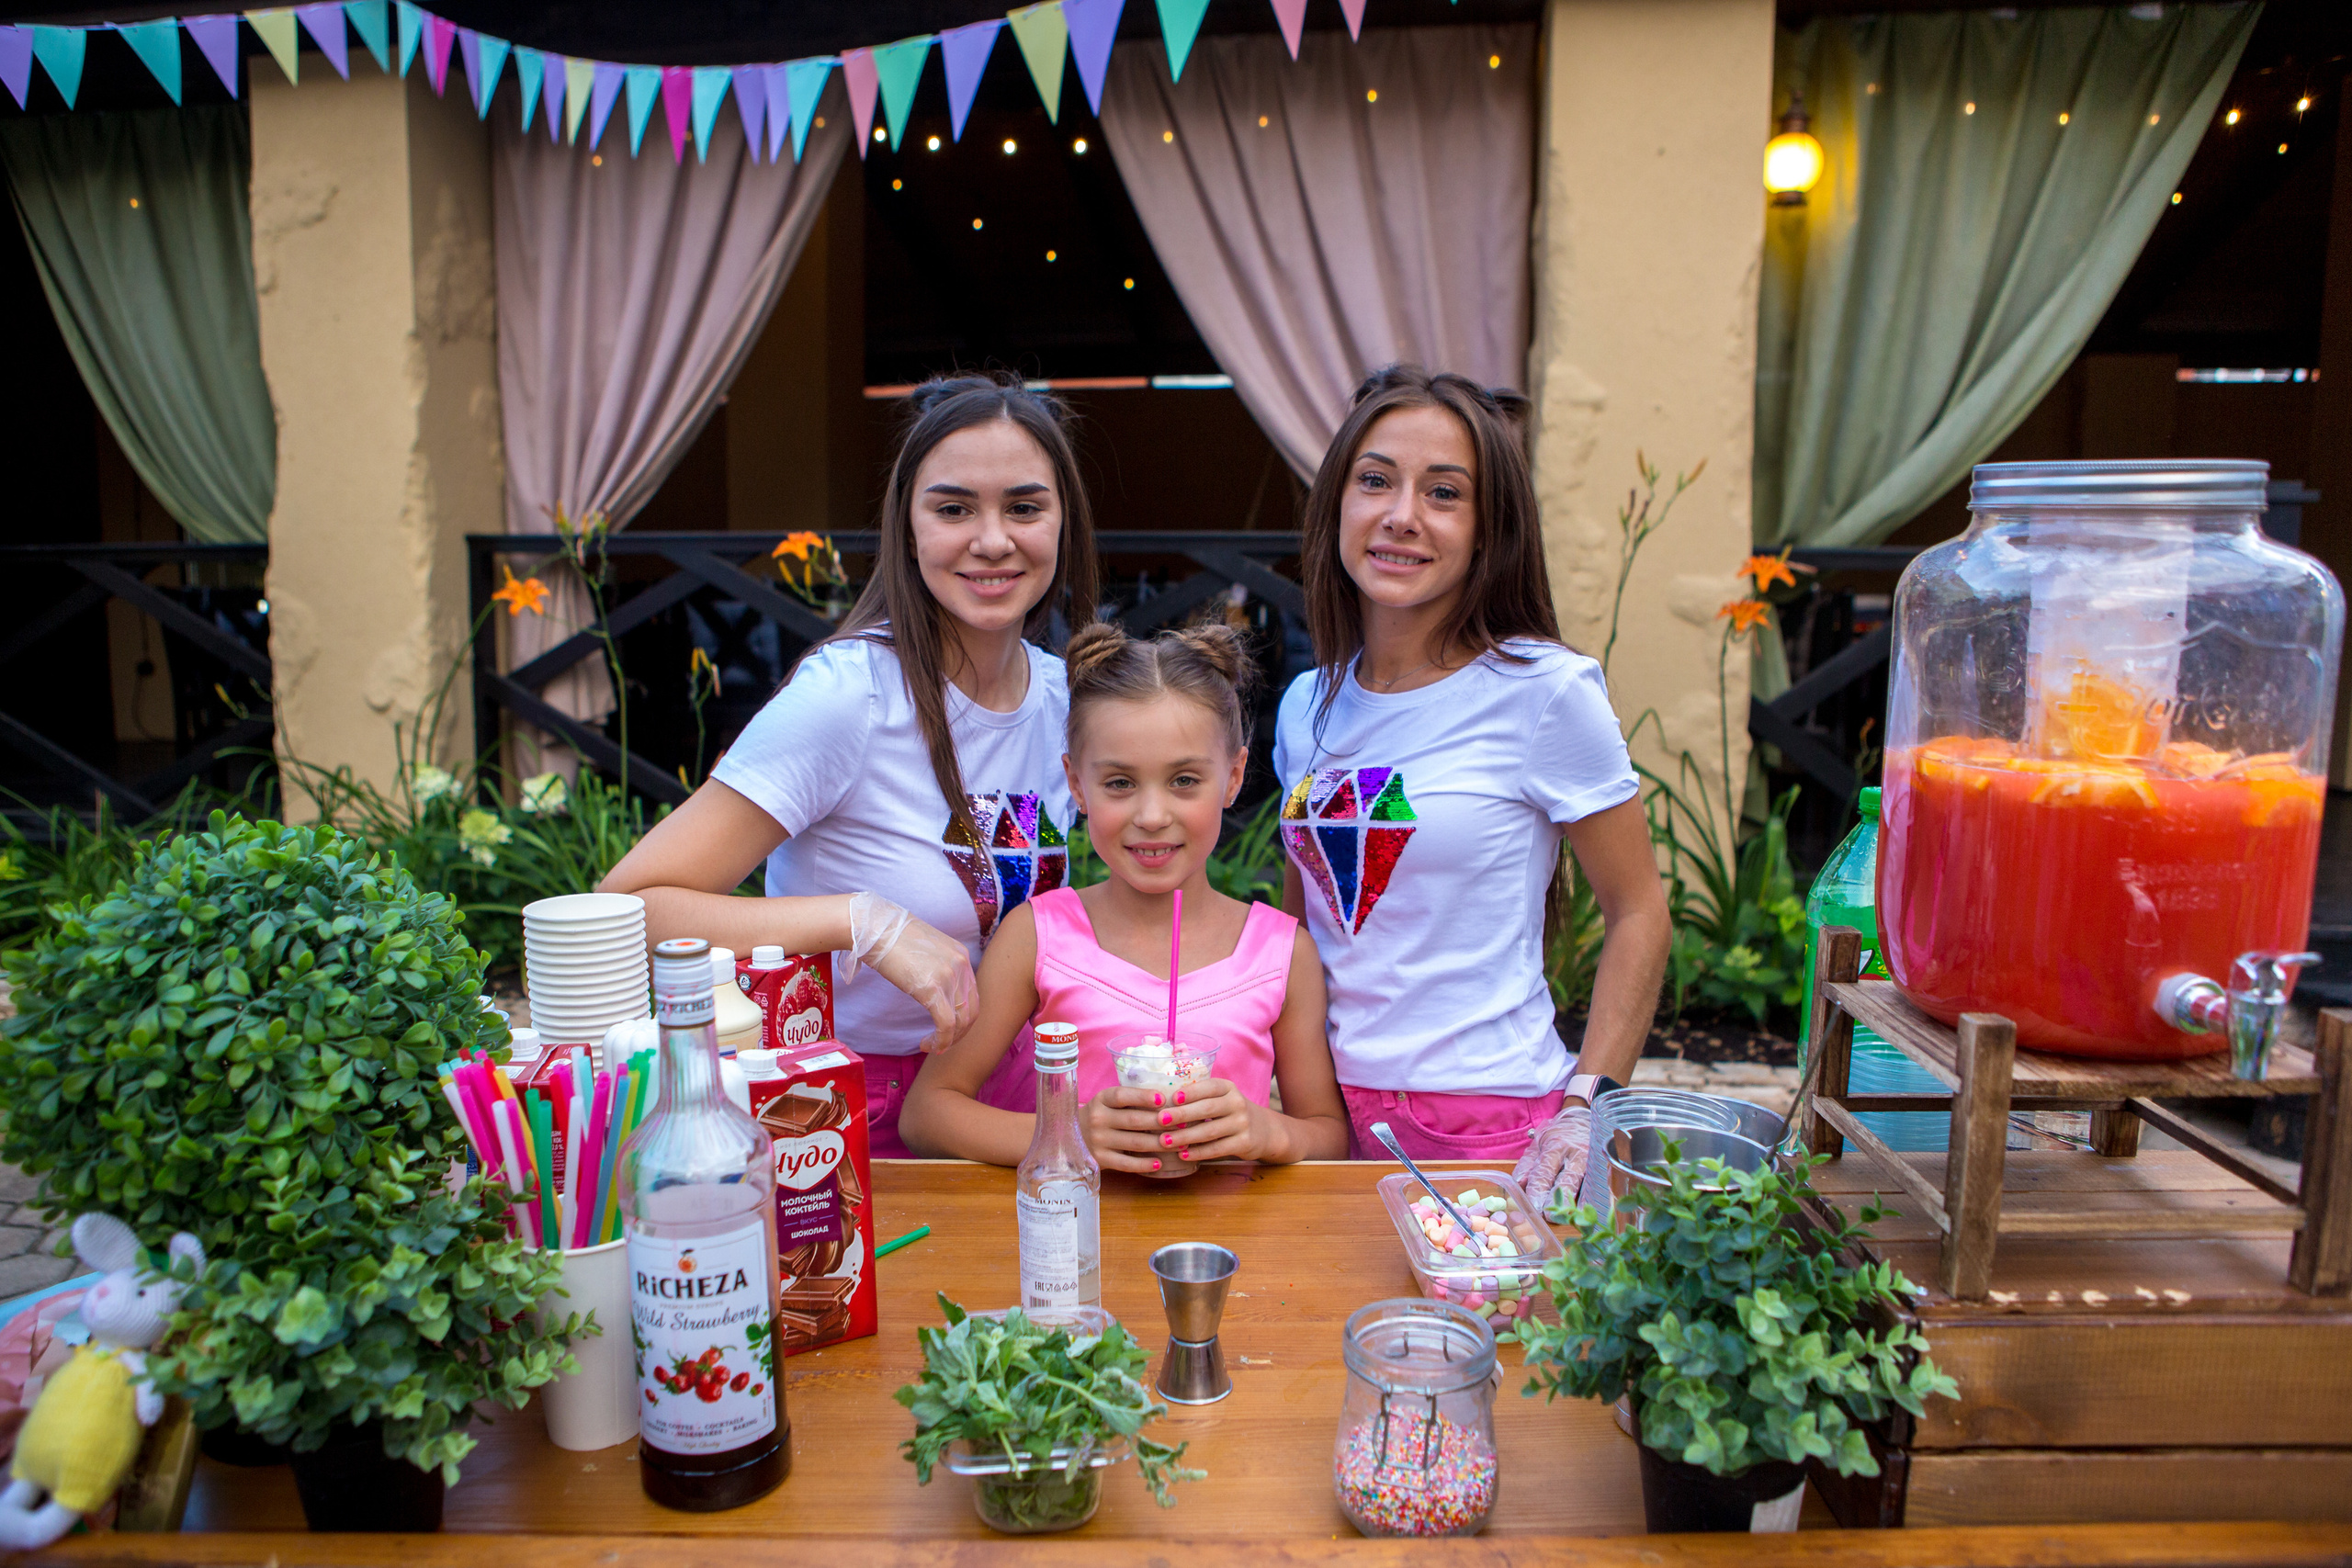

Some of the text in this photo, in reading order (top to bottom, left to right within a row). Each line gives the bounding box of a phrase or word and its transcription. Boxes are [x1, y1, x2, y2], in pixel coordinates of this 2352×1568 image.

[787, 1020, 820, 1045] Чудо
[781, 1189, 832, 1208] МОЛОЧНЫЙ
[785, 1201, 831, 1217] КОКТЕЙЛЬ
[799, 1216, 819, 1225] ВКУС
[791, 1224, 830, 1239] ШОКОЛАД
[633, 1301, 762, 1332] Wild Strawberry
[668, 1422, 695, 1431] COFFEE
[705, 1416, 744, 1430] COCKTAILS
